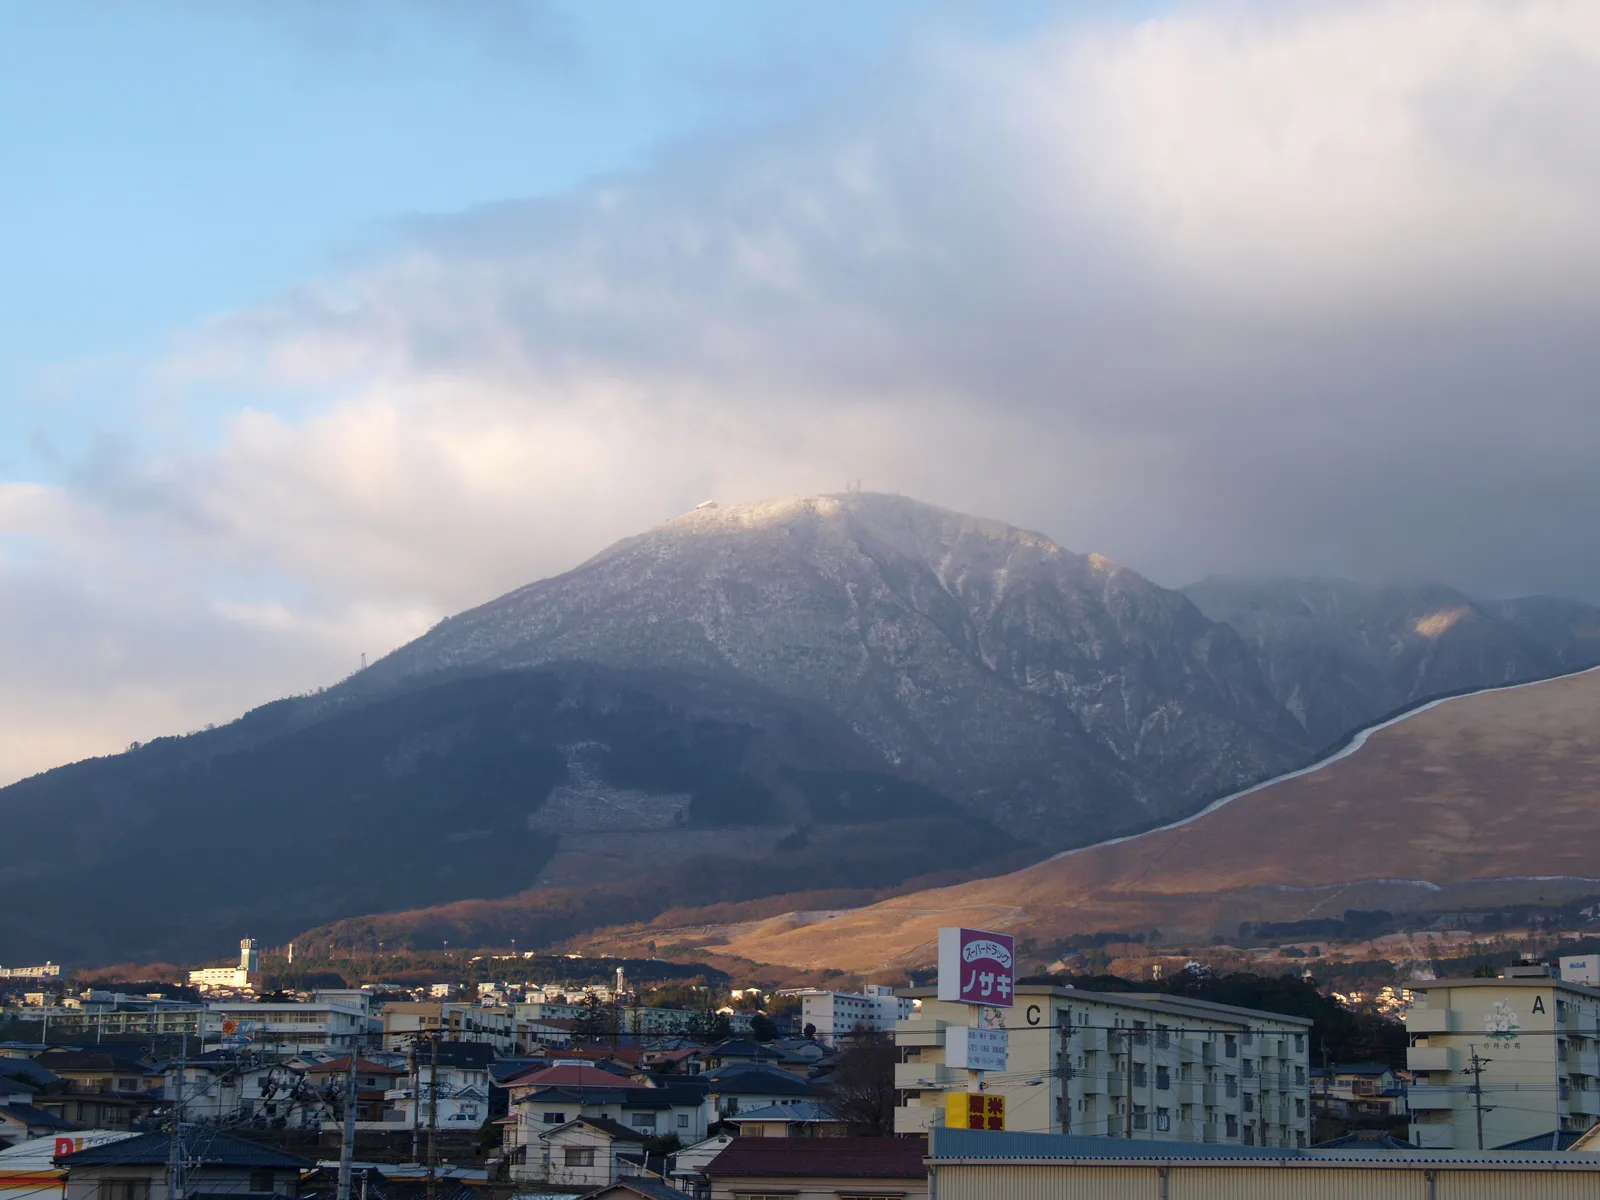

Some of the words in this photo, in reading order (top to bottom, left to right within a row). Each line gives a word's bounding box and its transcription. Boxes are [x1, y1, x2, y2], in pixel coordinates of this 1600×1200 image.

[962, 969, 1011, 999] ノサキ
[1026, 1004, 1041, 1026] C
[1532, 995, 1546, 1014] A
